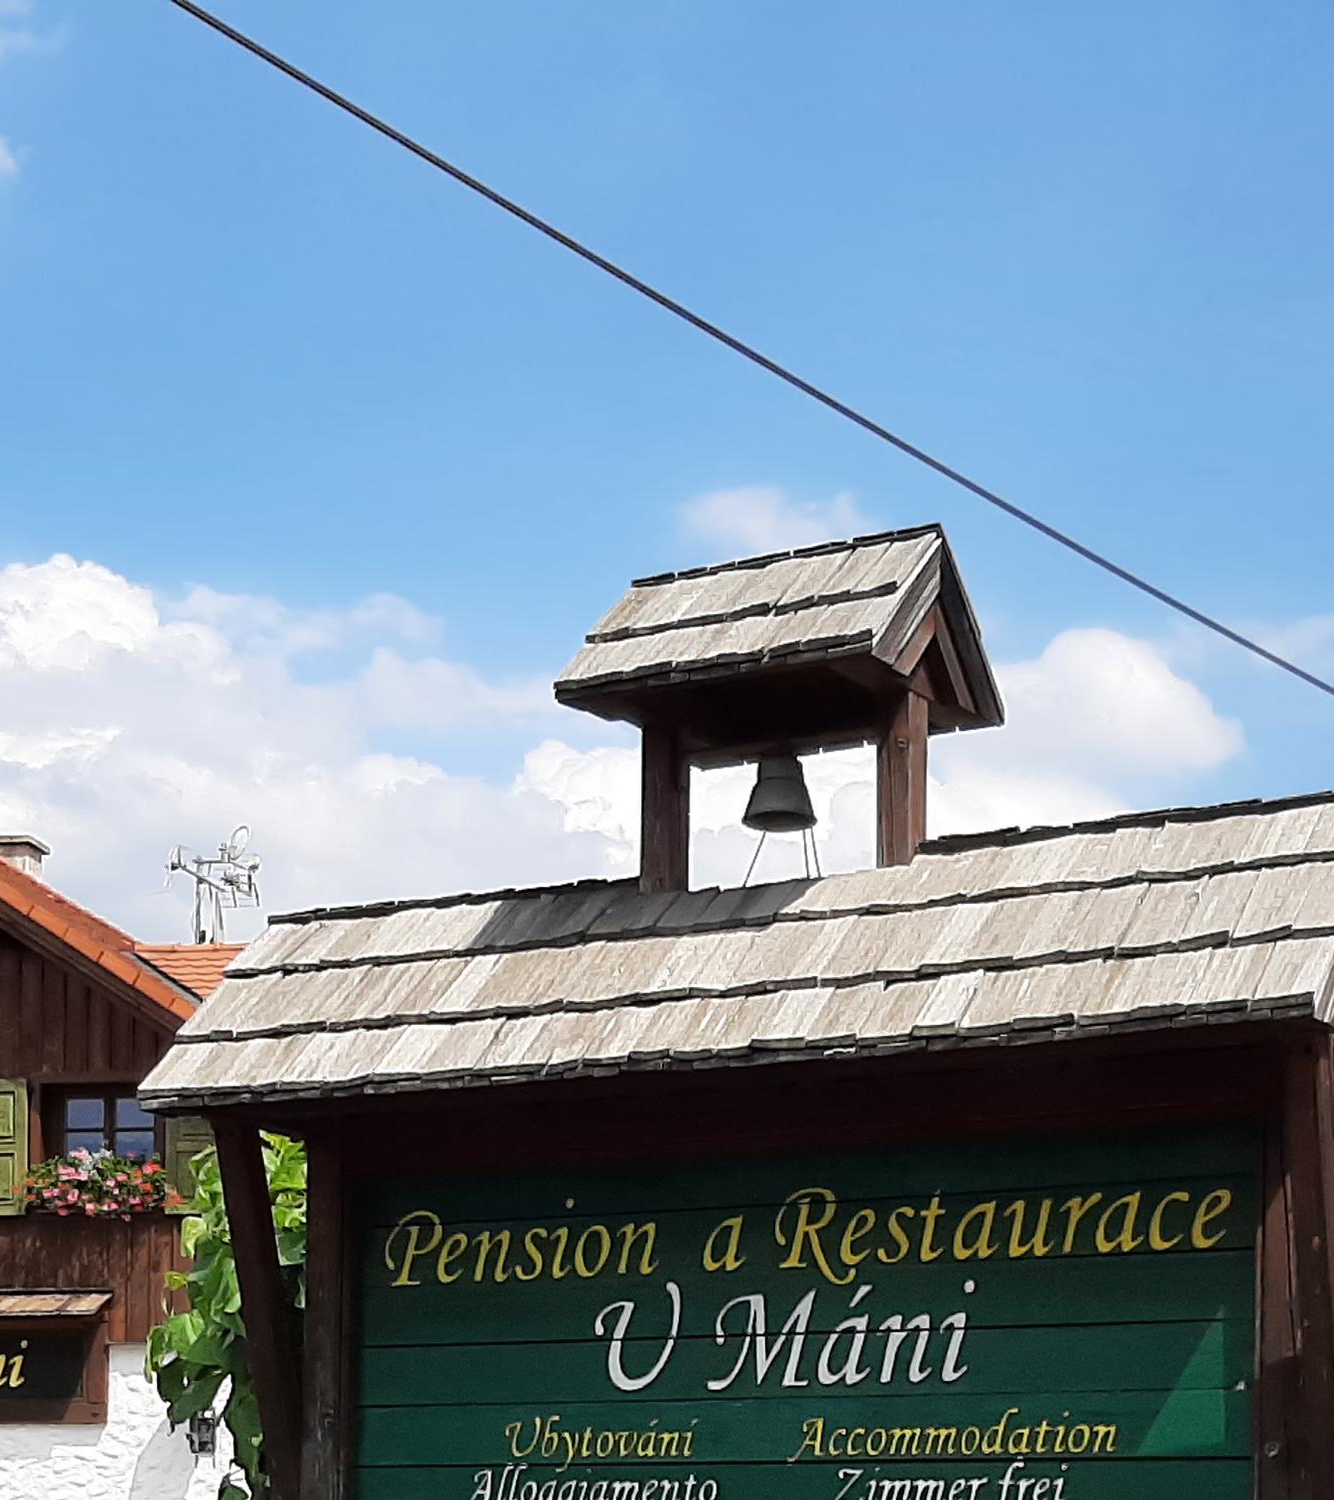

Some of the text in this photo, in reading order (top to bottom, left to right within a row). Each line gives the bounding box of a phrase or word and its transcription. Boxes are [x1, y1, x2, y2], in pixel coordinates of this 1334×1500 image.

[385, 1187, 1232, 1287] Pension a Restaurace
[595, 1279, 975, 1391] U Máni
[505, 1415, 699, 1472] Ubytování
[788, 1408, 1117, 1461] Accommodation
